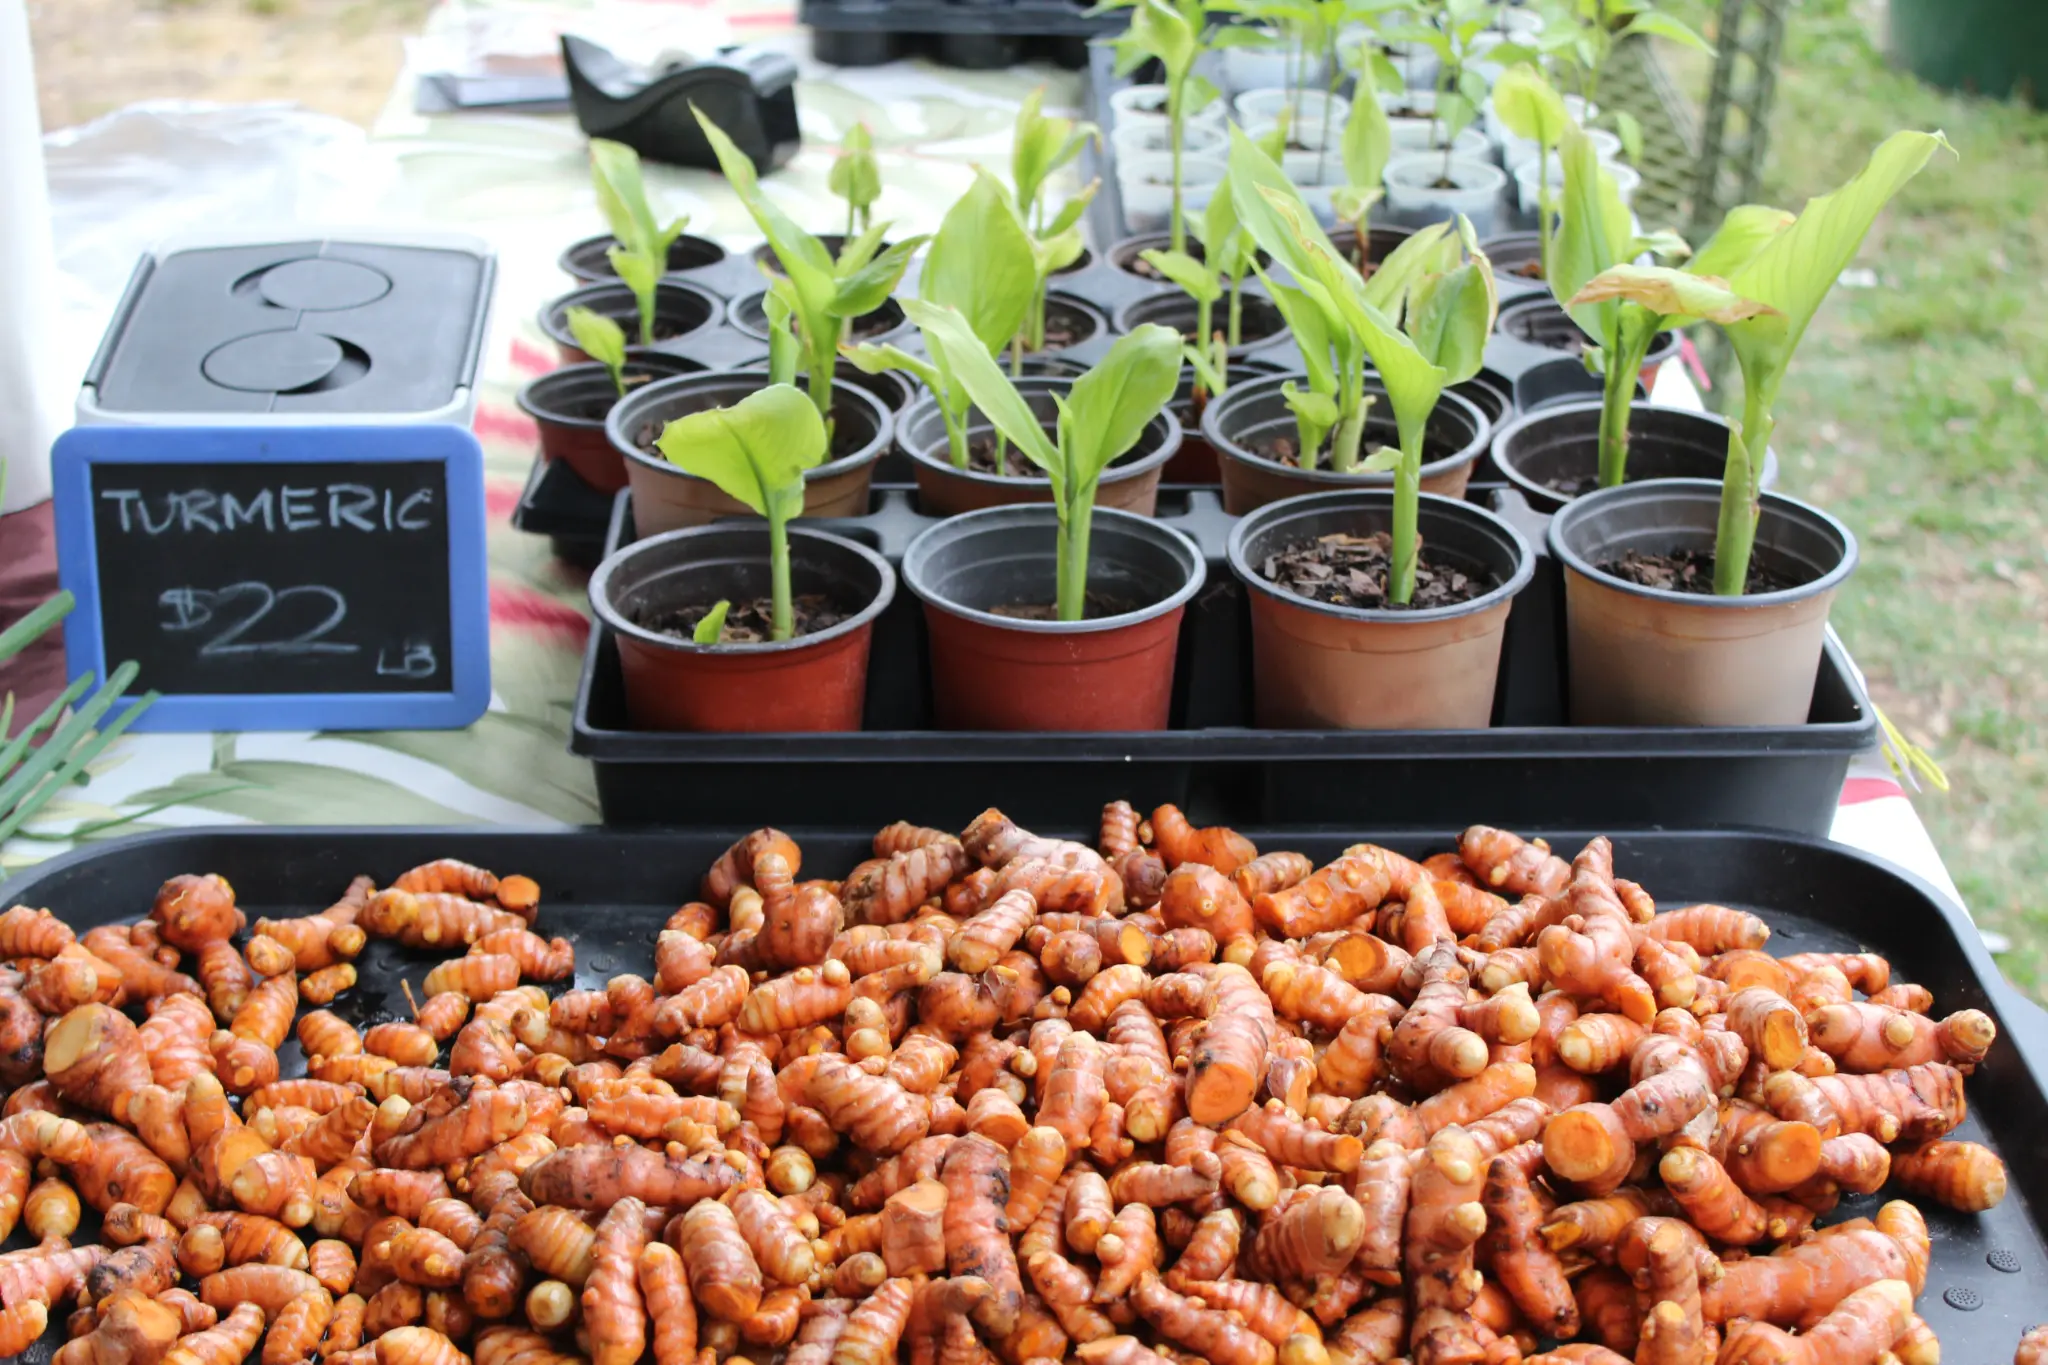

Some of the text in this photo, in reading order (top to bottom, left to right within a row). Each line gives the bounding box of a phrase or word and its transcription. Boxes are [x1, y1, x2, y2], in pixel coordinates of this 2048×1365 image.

[101, 484, 433, 534] TURMERIC
[158, 581, 437, 678] $22 LB
